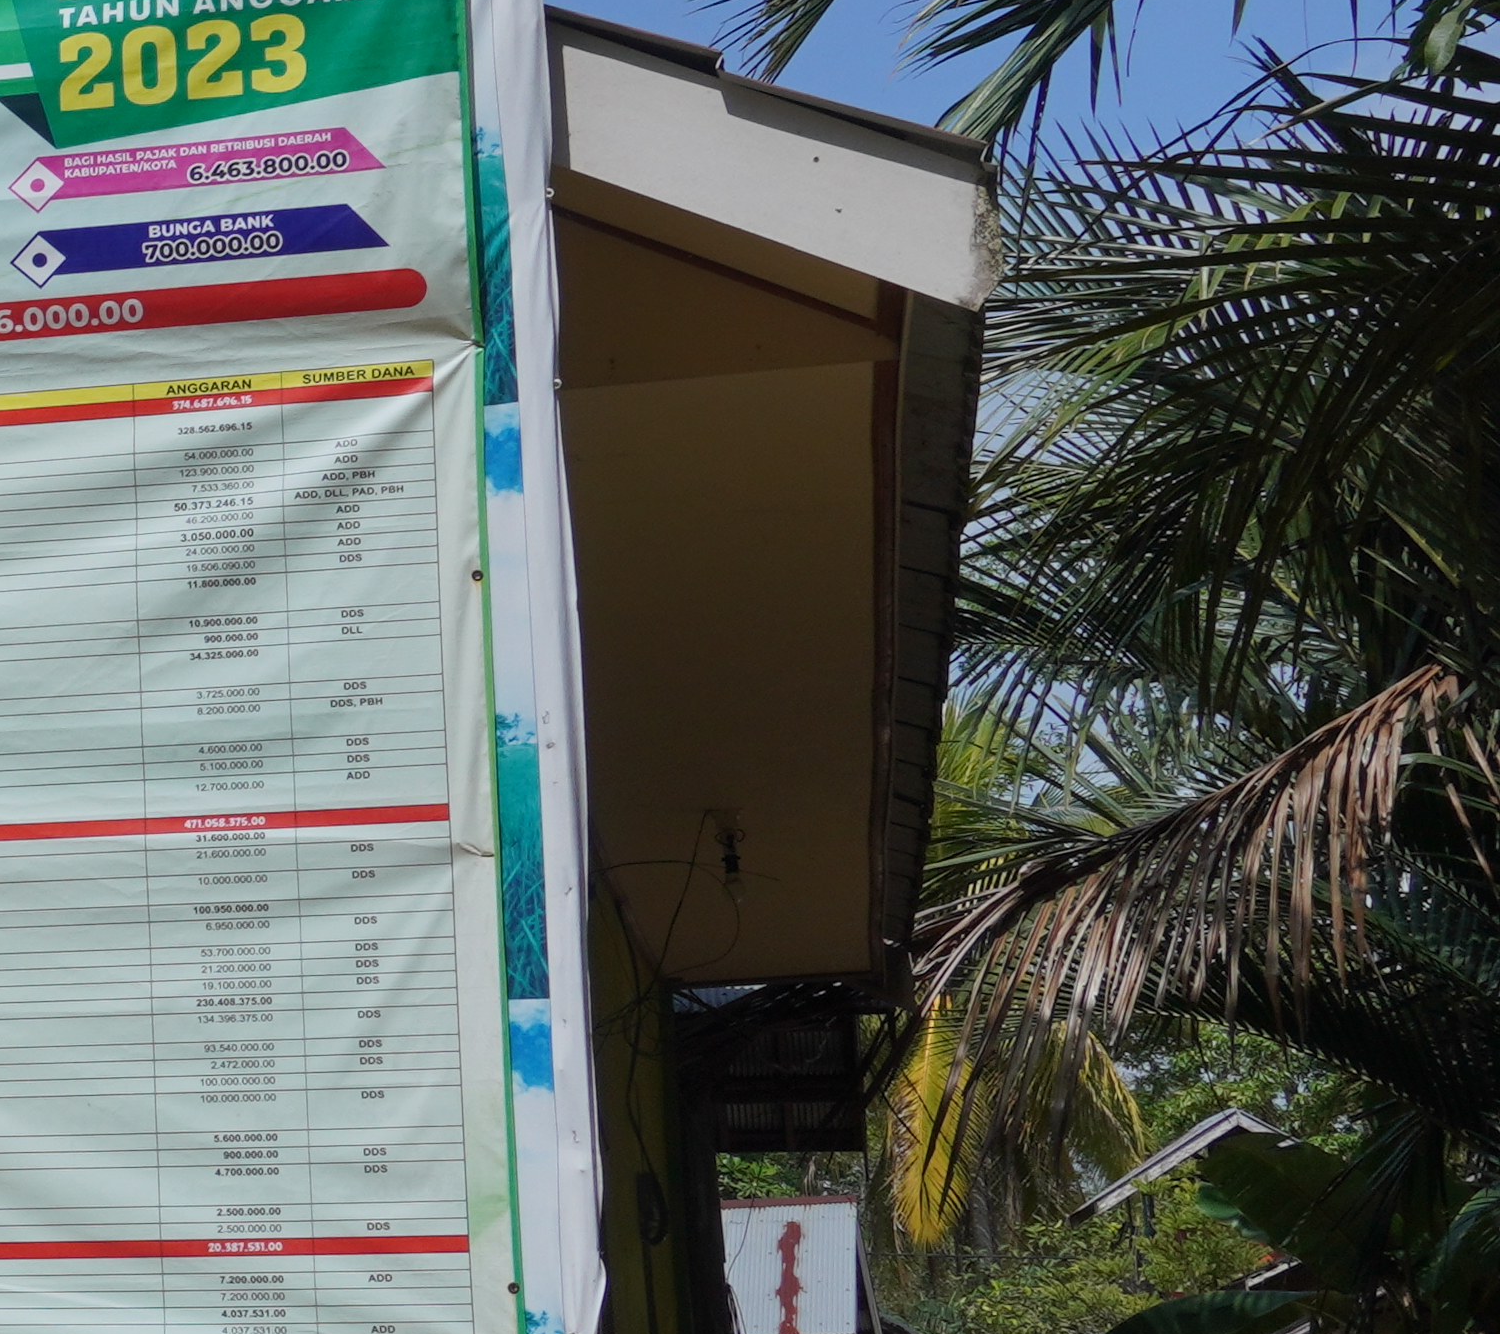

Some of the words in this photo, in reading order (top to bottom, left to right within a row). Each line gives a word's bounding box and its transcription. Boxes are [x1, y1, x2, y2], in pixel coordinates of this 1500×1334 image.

[59, 13, 307, 112] 2023
[64, 155, 94, 167] BAGI
[96, 152, 134, 165] HASIL
[136, 148, 176, 163] PAJAK
[179, 146, 206, 158] DAN
[210, 137, 275, 155] RETRIBUSI
[278, 132, 332, 146] DAERAH
[64, 159, 177, 179] KABUPATEN/KOTA
[187, 149, 350, 185] 6.463.800.00
[148, 219, 216, 239] BUNGA
[220, 213, 274, 232] BANK
[142, 231, 283, 263] 700.000.00
[166, 379, 252, 396] ANGGARAN
[302, 369, 366, 384] SUMBER
[371, 366, 415, 379] DANA
